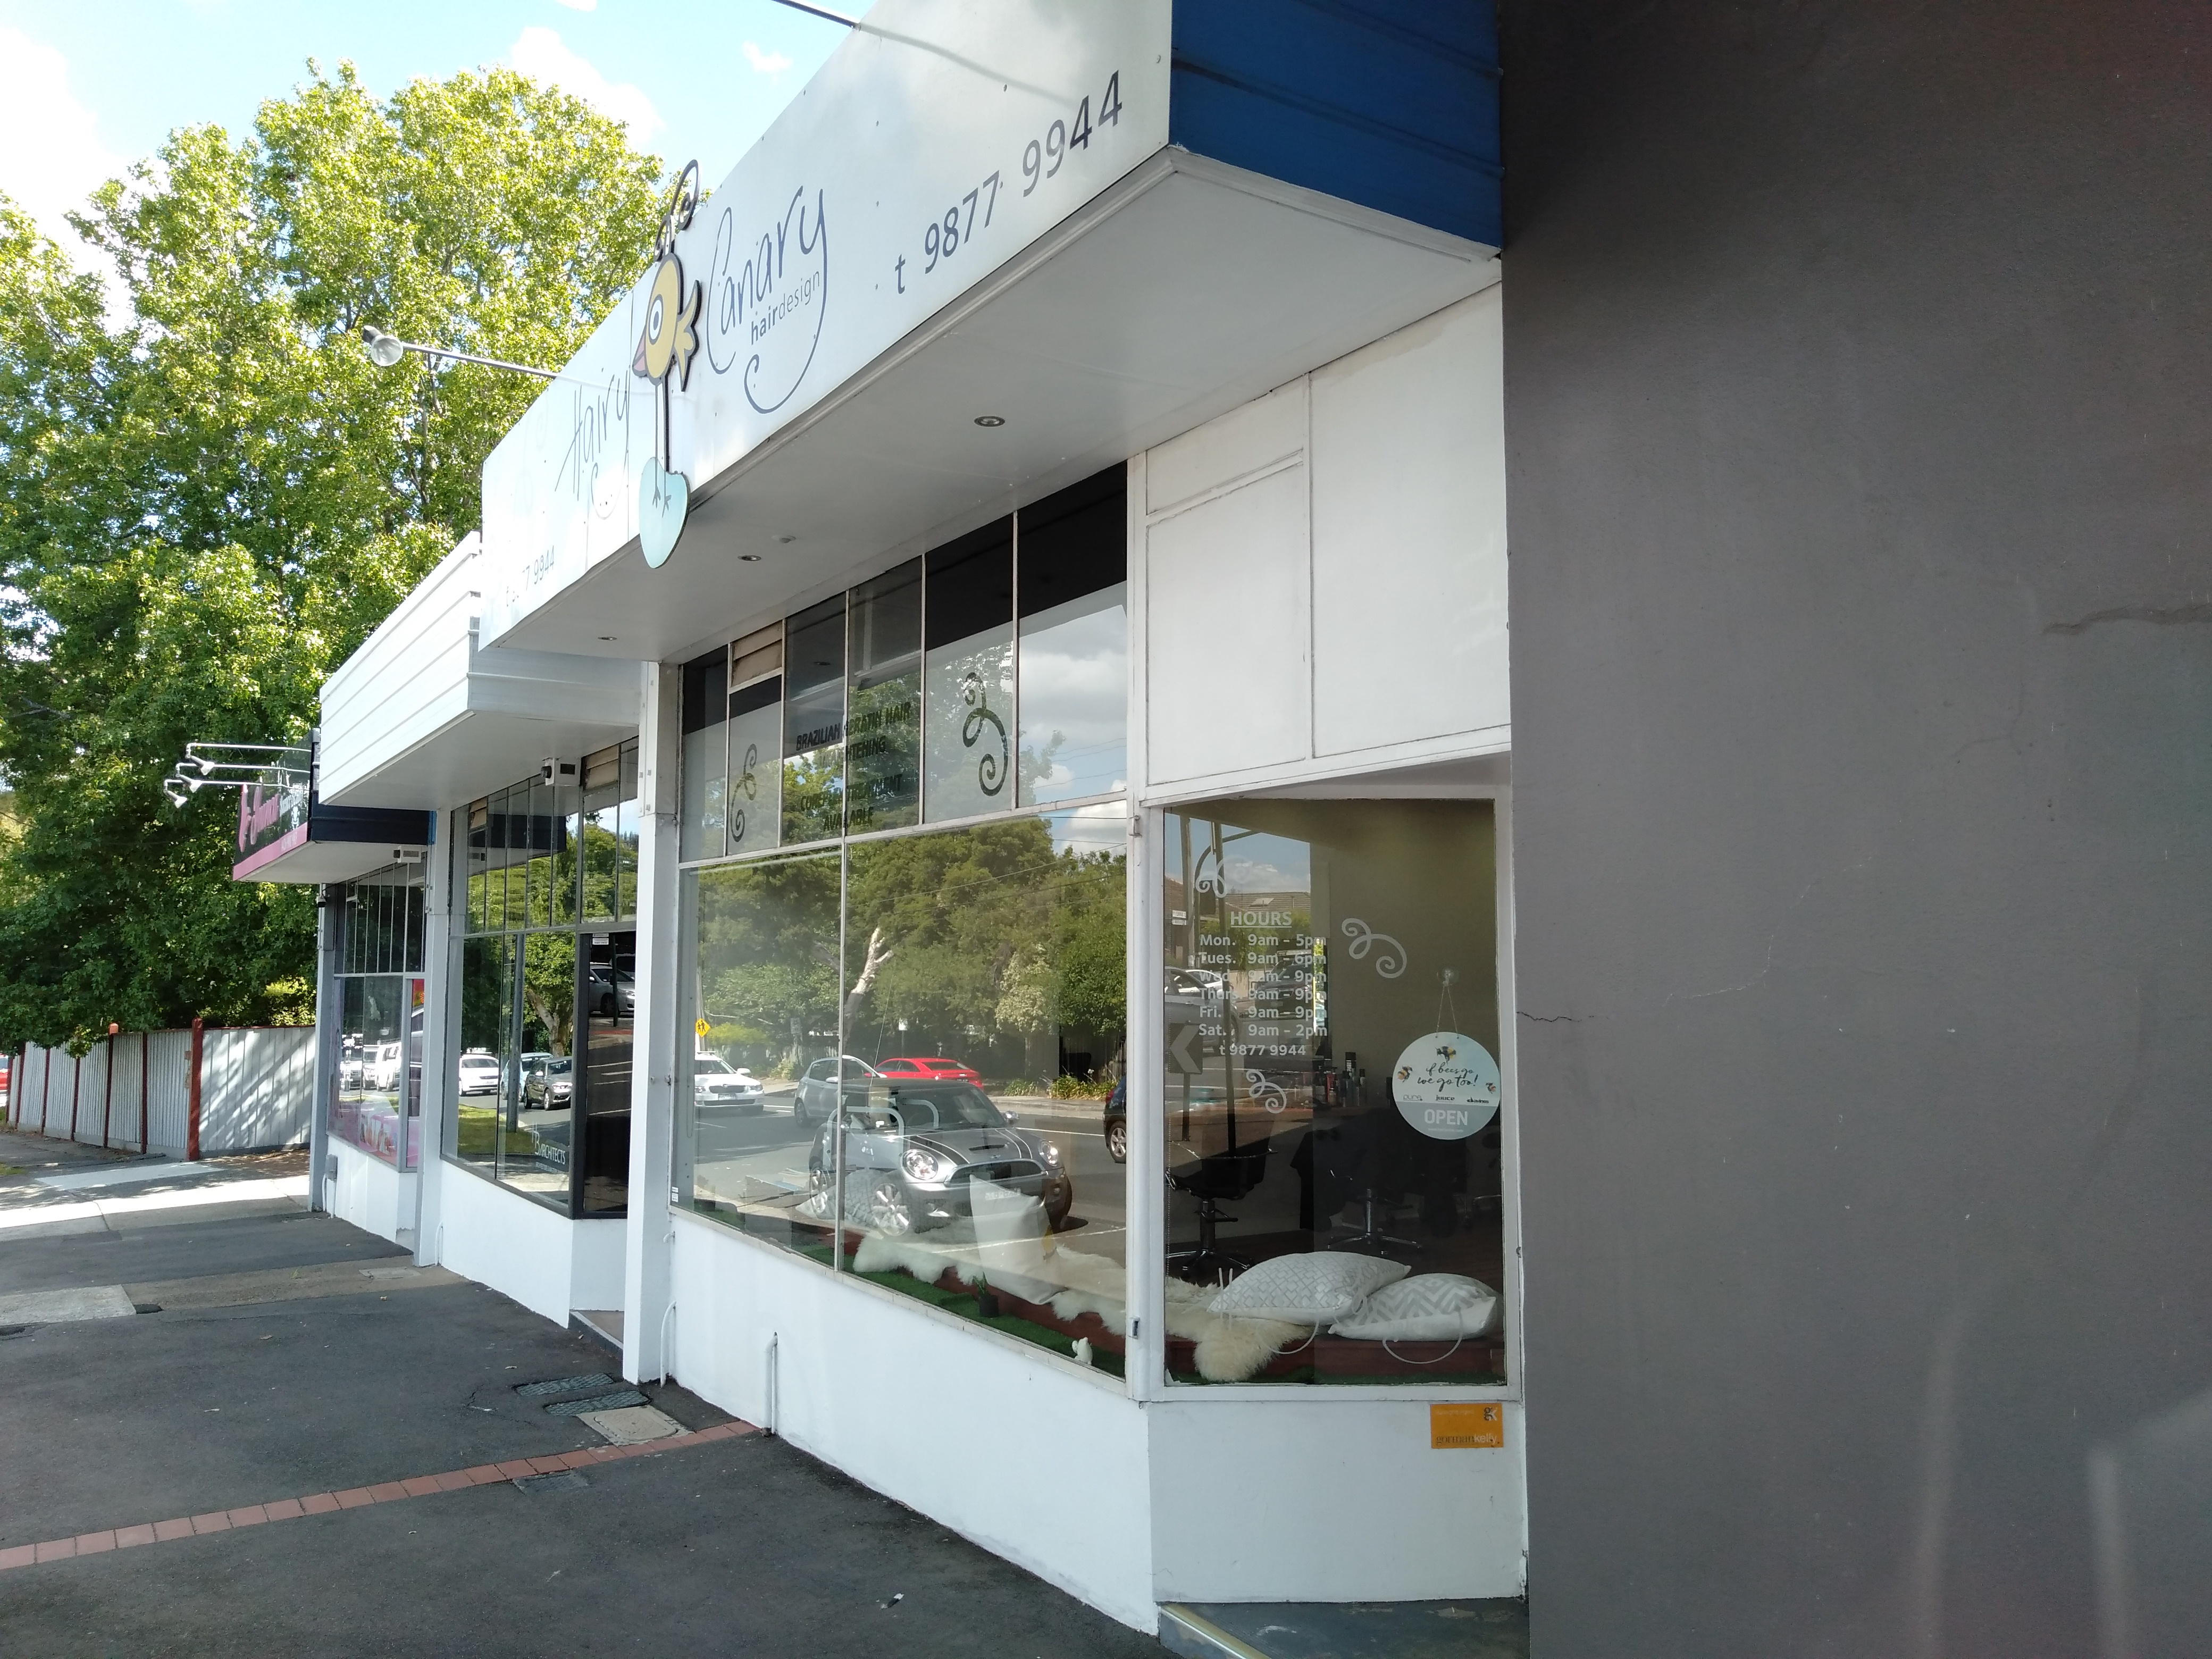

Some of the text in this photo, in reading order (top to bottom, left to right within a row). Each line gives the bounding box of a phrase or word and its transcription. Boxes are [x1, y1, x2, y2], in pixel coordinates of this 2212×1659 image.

[894, 69, 1123, 295] t 9877 9944
[751, 271, 820, 346] hairdesign
[534, 544, 554, 585] 9944
[795, 723, 841, 751] BRAZILIAN
[885, 701, 911, 725] HAIR
[1231, 911, 1292, 926] HOURS
[1200, 934, 1236, 946] Mon.
[1247, 934, 1279, 946] 9am
[1296, 934, 1327, 949] 5pm
[1199, 952, 1236, 964] Tues.
[1247, 952, 1279, 964] 9am
[1295, 952, 1327, 967] 6pm
[1247, 970, 1279, 982] 9am
[1295, 970, 1327, 985] 9pm
[1247, 988, 1279, 1000] 9am
[1295, 988, 1327, 1003] 9pm
[1199, 1005, 1222, 1018] Fri.
[1247, 1006, 1279, 1018] 9am
[1295, 1006, 1327, 1021] 9pm
[1199, 1024, 1227, 1036] Sat.
[1247, 1024, 1279, 1036] 9am
[1296, 1024, 1328, 1040] 2pm
[1219, 1044, 1306, 1056] t 9877 9944
[1426, 1061, 1474, 1079] if bees go
[1436, 1078, 1454, 1092] go
[1454, 1074, 1478, 1087] too!
[1424, 1109, 1468, 1126] OPEN
[539, 1143, 566, 1165] ARCHITECTS
